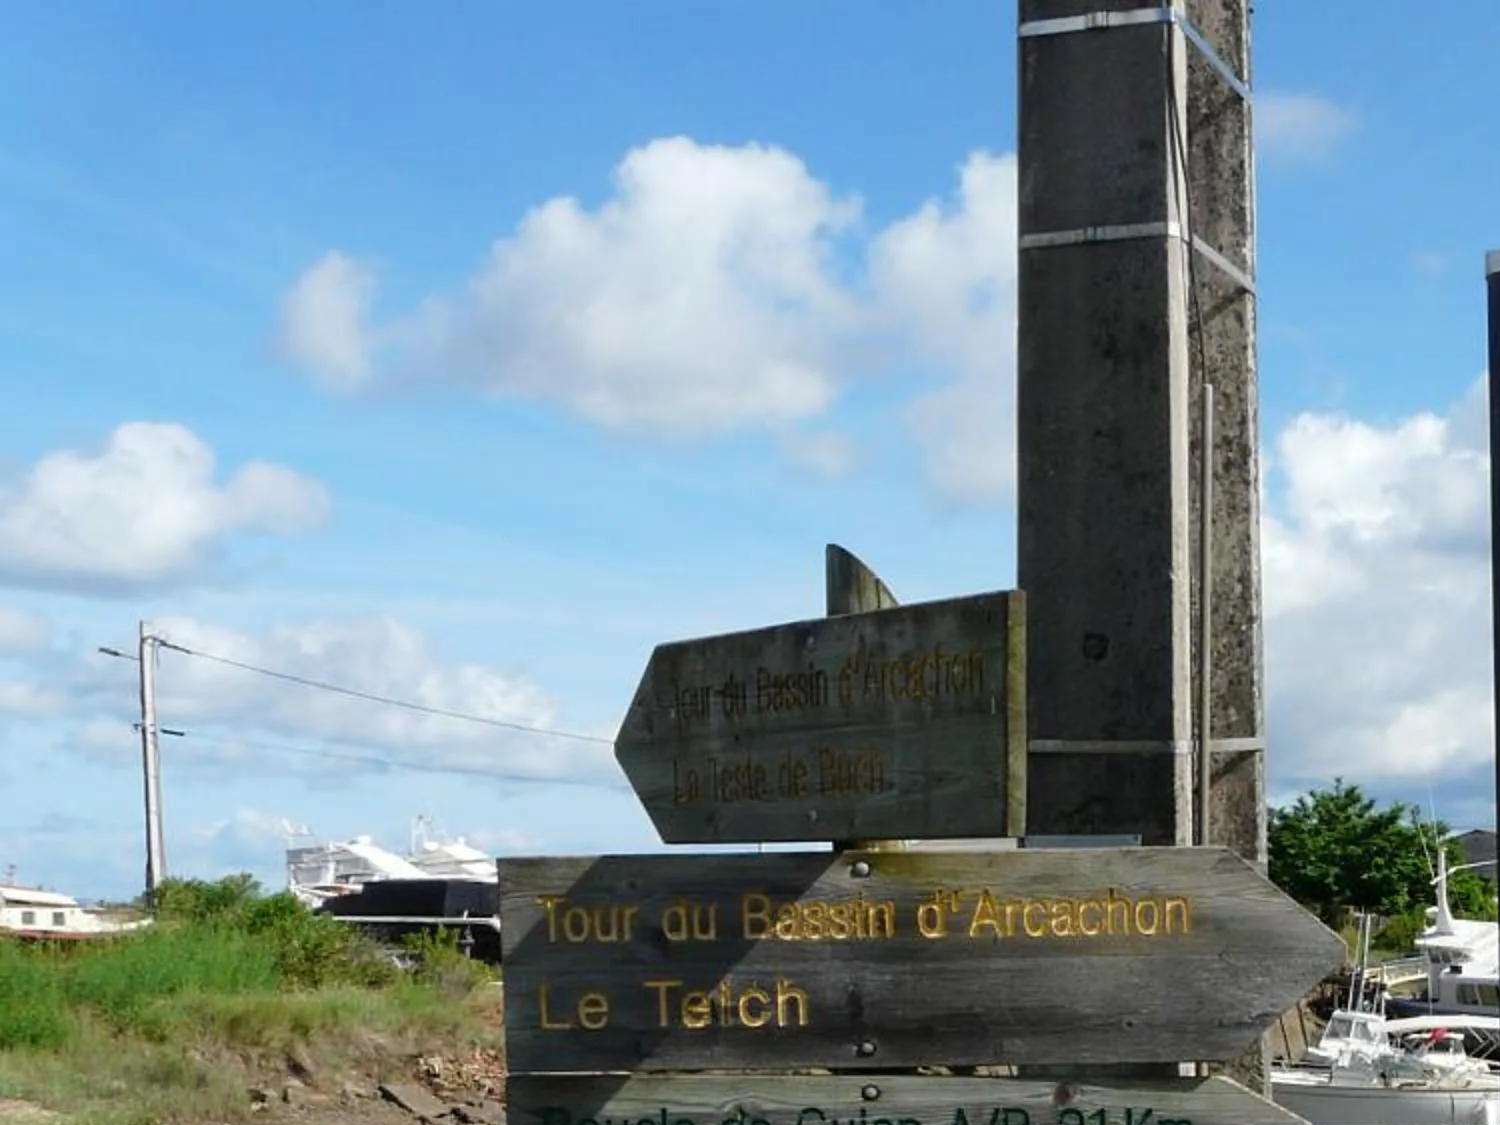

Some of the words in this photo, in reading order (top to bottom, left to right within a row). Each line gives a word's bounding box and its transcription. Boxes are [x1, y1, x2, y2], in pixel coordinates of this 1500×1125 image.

[755, 658, 830, 712] Bassin
[707, 751, 768, 802] Teste
[777, 749, 809, 797] de
[536, 894, 638, 942] Tour
[660, 894, 718, 941] du
[742, 889, 896, 941] Bassin
[917, 886, 1193, 939] d'Arcachon
[538, 976, 609, 1031] Le
[643, 972, 809, 1030] Teich
